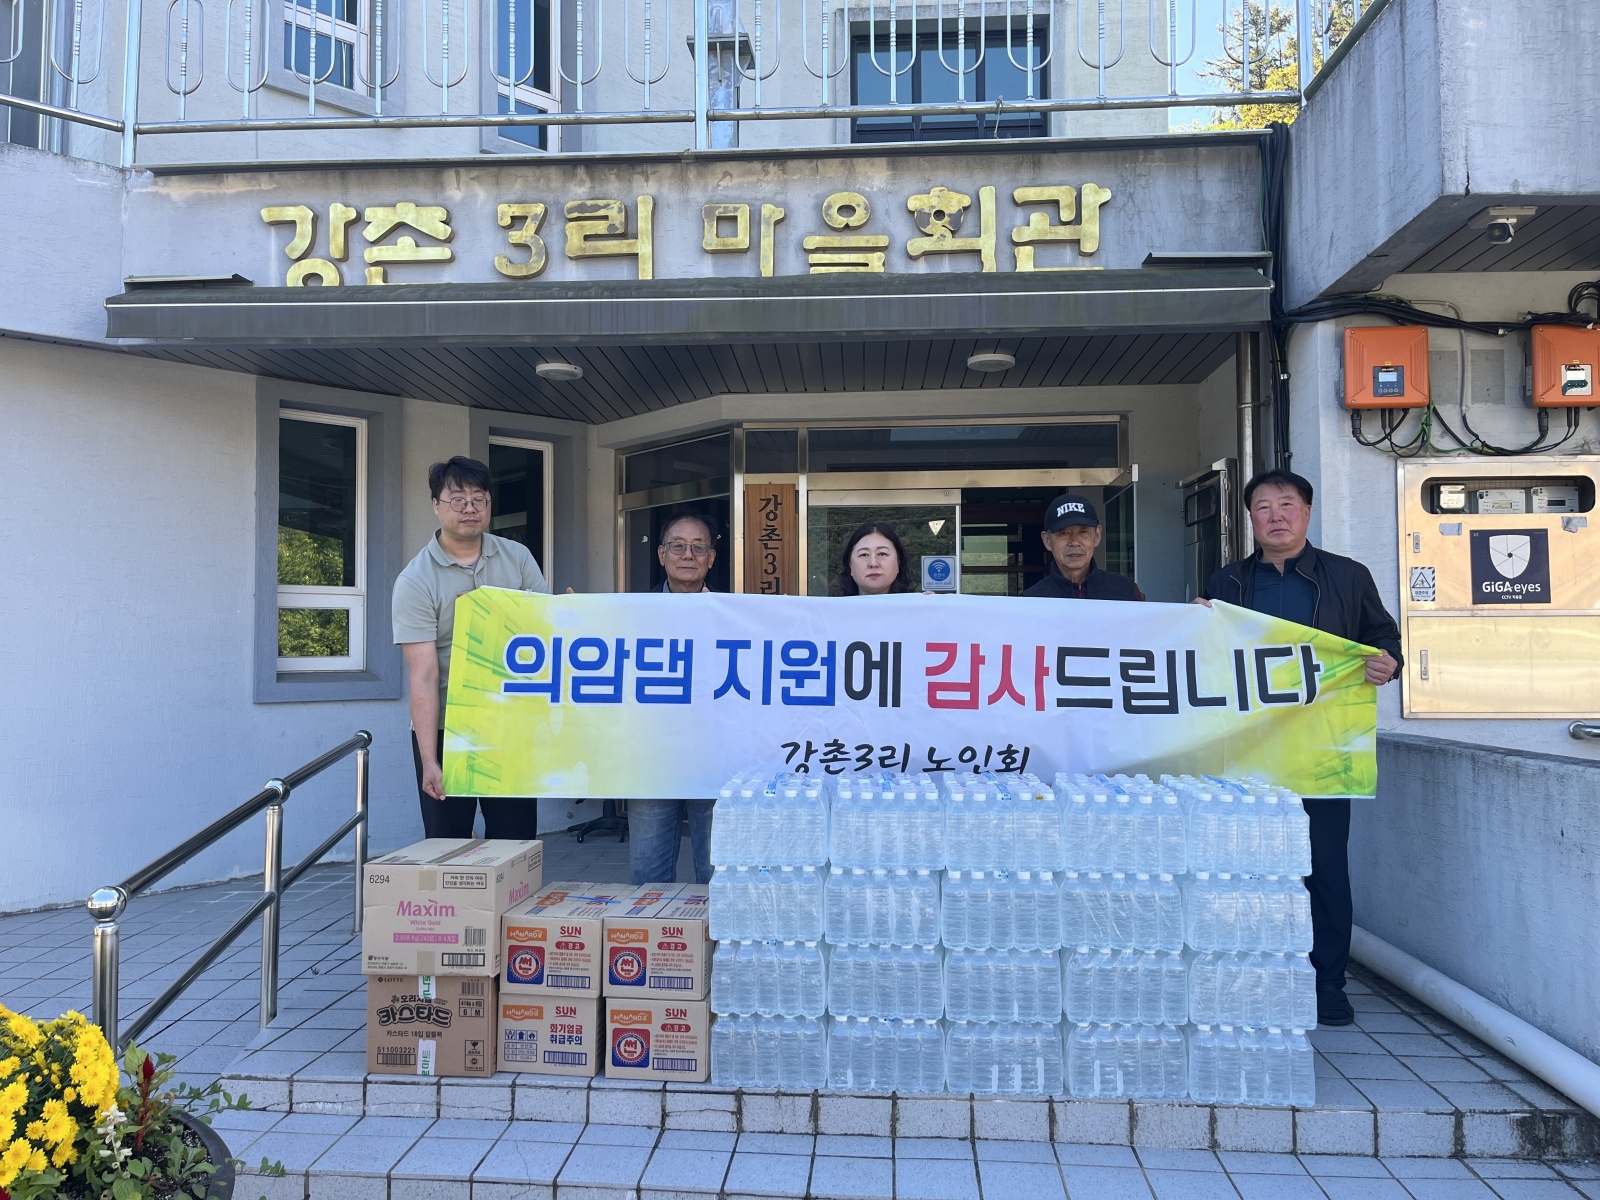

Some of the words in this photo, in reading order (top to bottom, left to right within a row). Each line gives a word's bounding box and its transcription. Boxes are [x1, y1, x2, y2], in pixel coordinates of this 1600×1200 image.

[702, 183, 1112, 277] 마을회관
[1056, 502, 1085, 517] NIKE
[1482, 581, 1513, 593] GiGA
[1513, 583, 1541, 595] eyes
[503, 636, 694, 705] 의암댐
[713, 639, 902, 708] 지원에
[925, 642, 1321, 715] 감사드립니다
[780, 738, 911, 776] 강촌3리
[922, 743, 1031, 777] 노인회
[369, 874, 390, 884] 6294
[508, 881, 529, 906] Maxim
[396, 898, 455, 917] Maxim
[560, 926, 581, 936] SUN
[661, 926, 683, 936] SUN
[377, 1004, 452, 1028] 카스타드
[555, 1006, 576, 1016] SUN
[665, 1008, 687, 1017] SUN
[386, 1030, 409, 1038] 카스타드
[550, 1023, 583, 1035] 화기엄금
[550, 1034, 582, 1045] 취급주의
